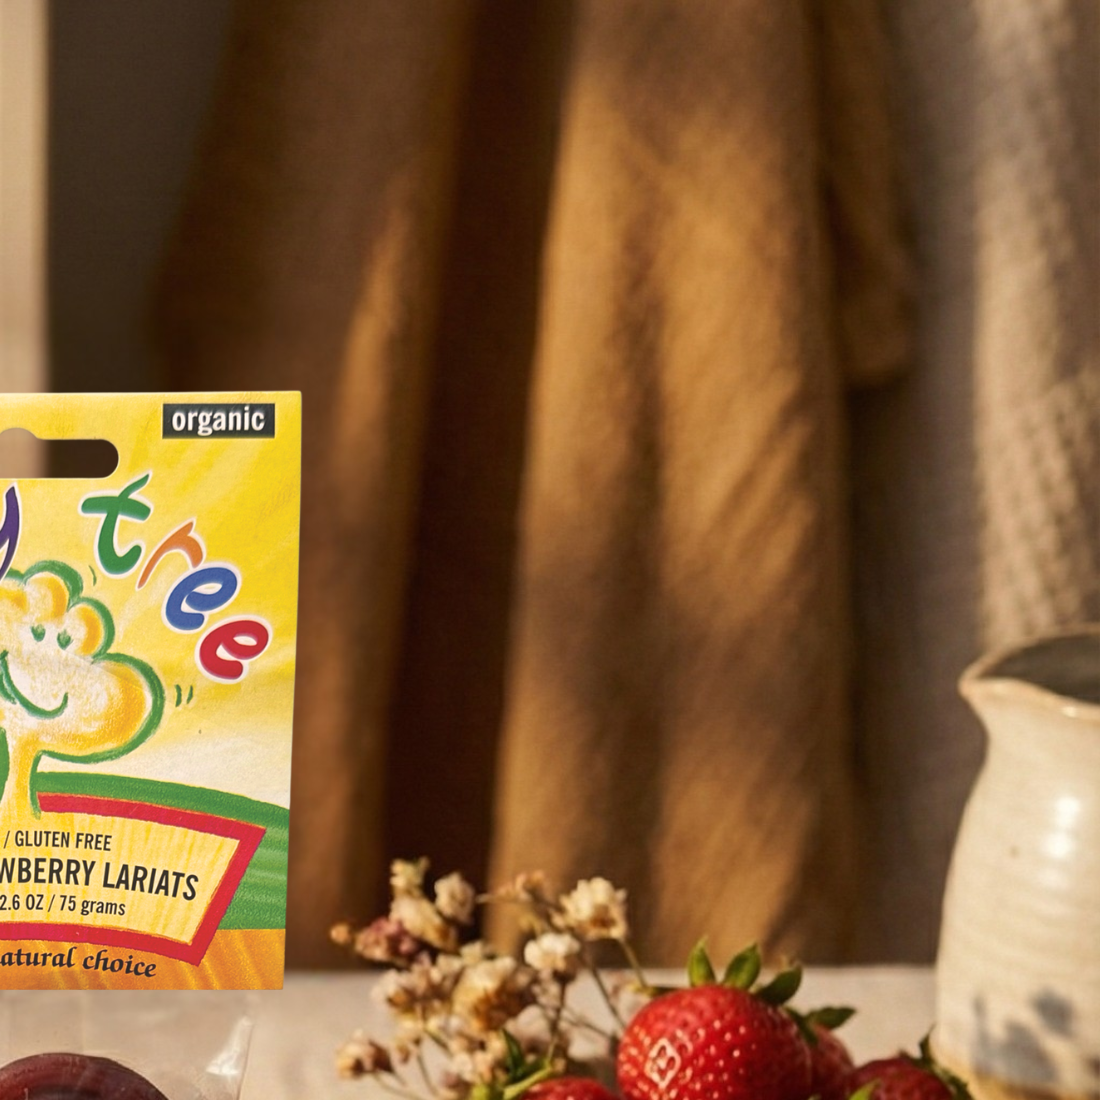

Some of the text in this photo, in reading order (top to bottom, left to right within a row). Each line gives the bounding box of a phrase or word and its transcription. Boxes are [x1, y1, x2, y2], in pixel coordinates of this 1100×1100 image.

[172, 404, 265, 436] organic
[81, 472, 269, 679] tree
[15, 830, 70, 848] GLUTEN
[76, 833, 112, 851] FREE
[102, 862, 199, 900] LARIATS
[0, 895, 20, 910] 2.6
[25, 894, 44, 910] OZ
[59, 895, 76, 911] 75
[81, 899, 125, 916] grams
[82, 950, 156, 977] choice
